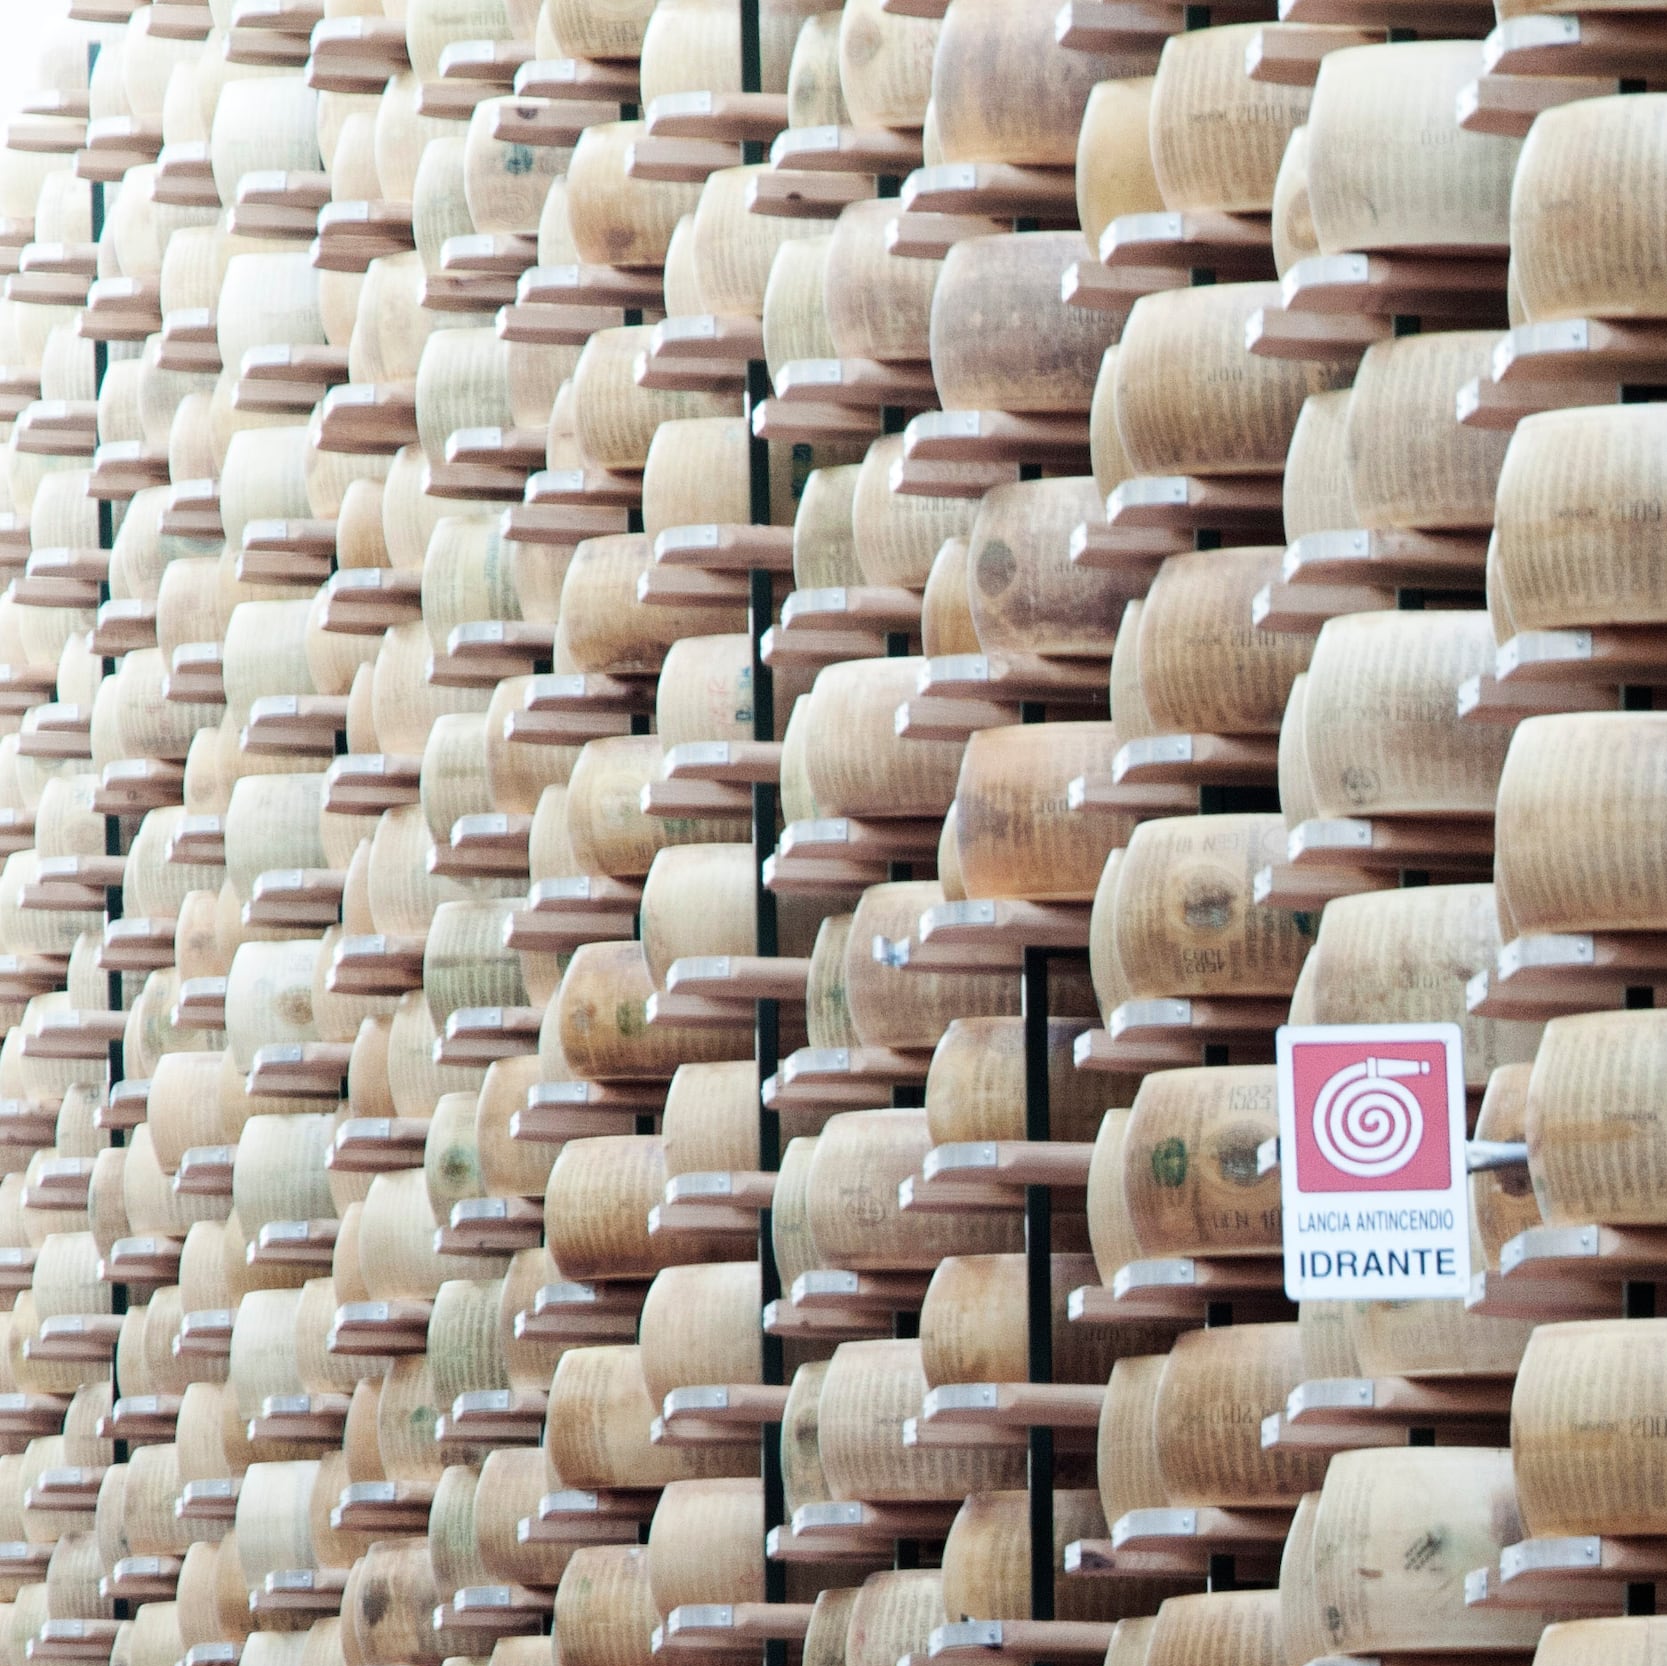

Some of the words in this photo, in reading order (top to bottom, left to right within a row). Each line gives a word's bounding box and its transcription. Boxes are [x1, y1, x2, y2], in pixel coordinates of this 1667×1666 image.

[1298, 1212, 1351, 1232] LANCIA
[1356, 1208, 1454, 1232] ANTINCENDIO
[1299, 1249, 1457, 1279] IDRANTE
